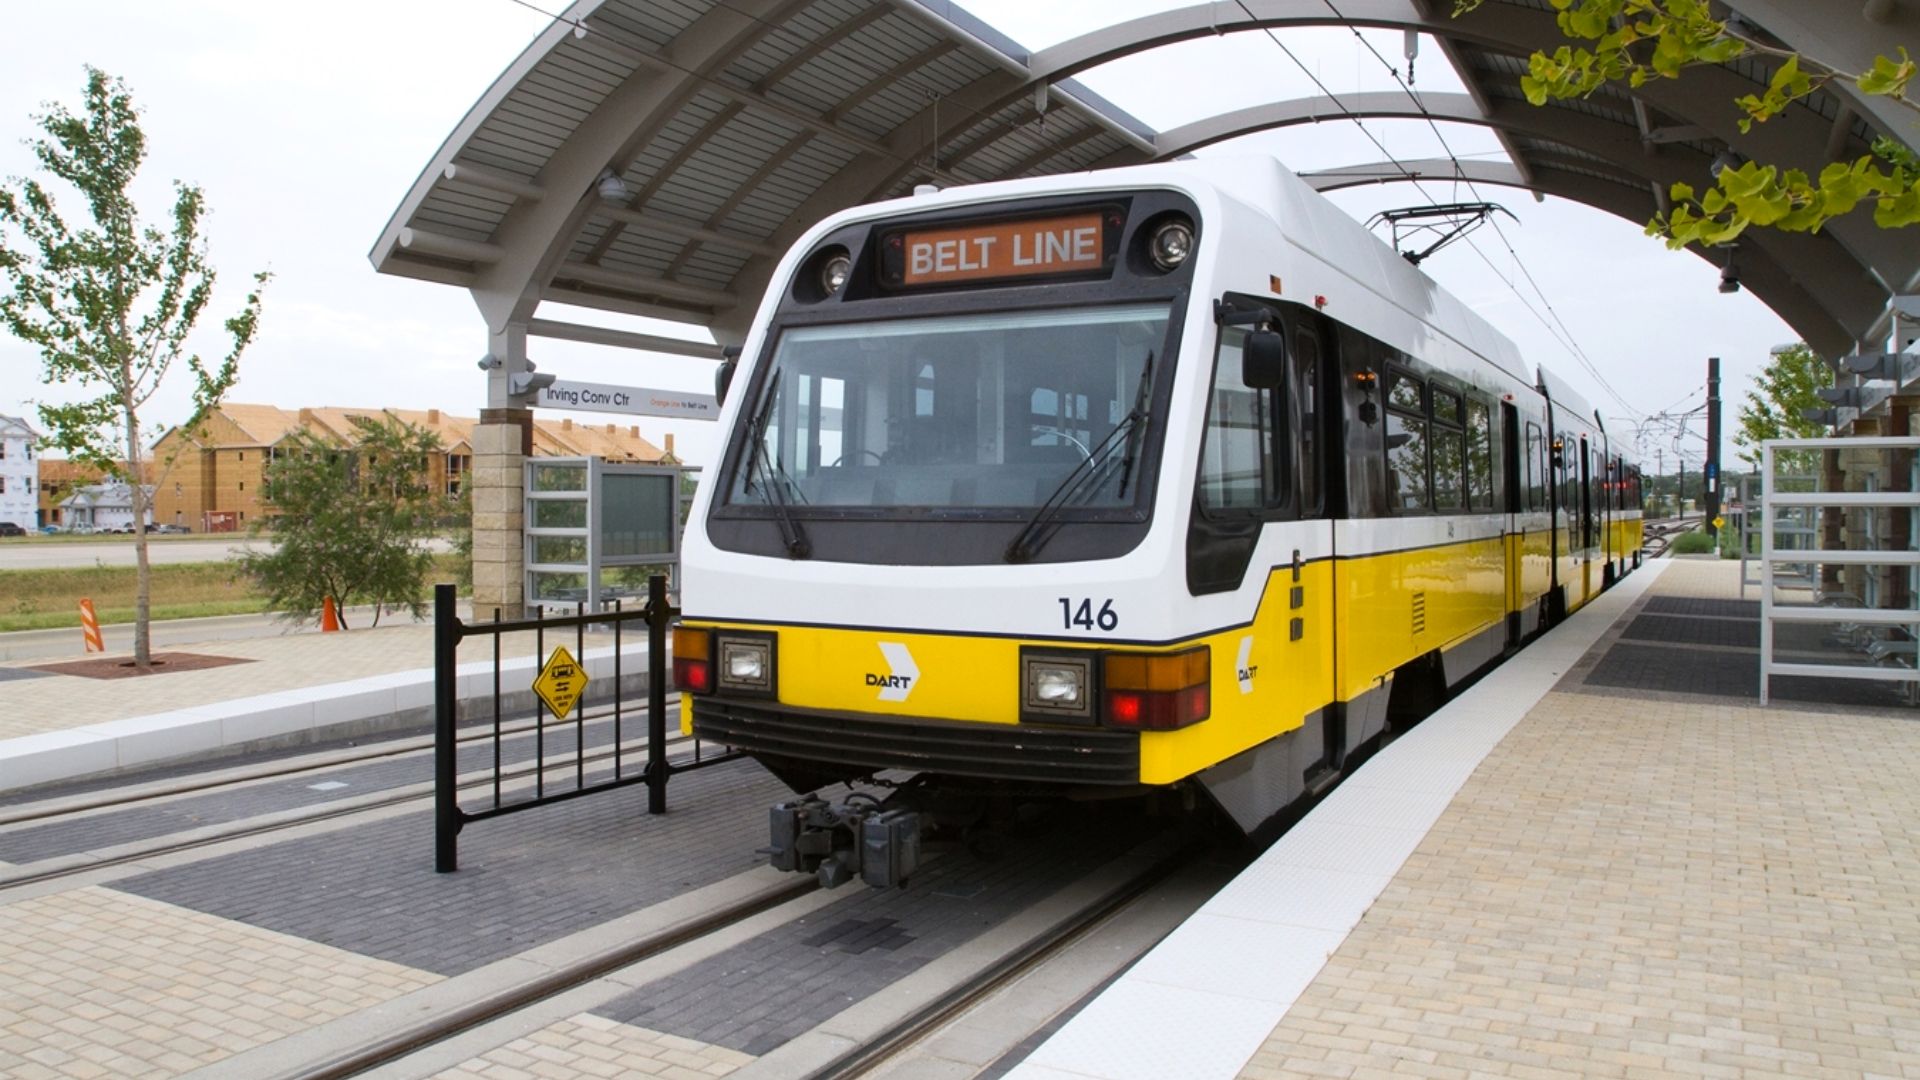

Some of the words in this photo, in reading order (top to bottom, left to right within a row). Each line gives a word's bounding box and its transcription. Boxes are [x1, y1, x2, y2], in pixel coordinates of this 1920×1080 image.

[911, 236, 997, 275] BELT
[1013, 227, 1096, 266] LINE
[547, 386, 578, 405] Irving
[581, 389, 611, 404] Conv
[613, 392, 630, 405] Ctr
[1058, 597, 1119, 631] 146
[865, 673, 911, 689] DART
[1238, 665, 1258, 682] DART
